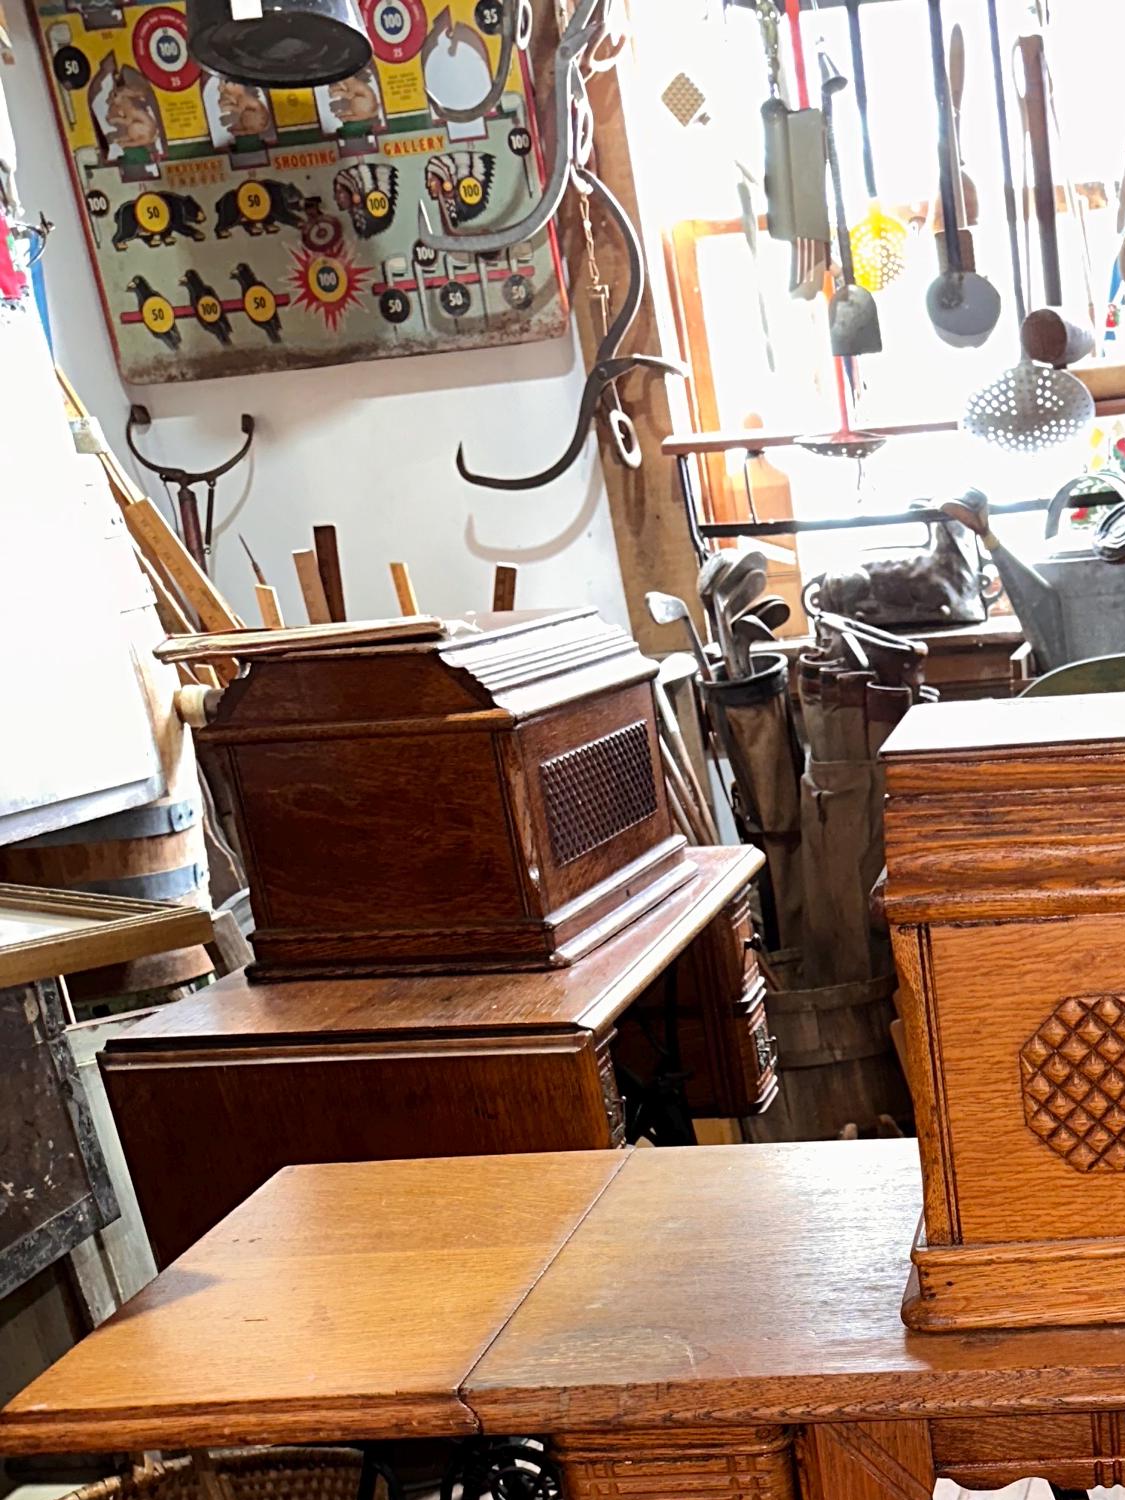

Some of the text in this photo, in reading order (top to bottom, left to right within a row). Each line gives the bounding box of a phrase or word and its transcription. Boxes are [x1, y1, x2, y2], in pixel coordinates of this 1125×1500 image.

[382, 14, 401, 29] 100
[483, 8, 498, 24] 35
[158, 42, 179, 57] 100
[64, 60, 80, 75] 50
[510, 132, 530, 150] 100
[273, 151, 337, 170] SHOOTING
[383, 136, 444, 156] GALLERY
[461, 183, 480, 198] 100
[88, 195, 108, 212] 100
[247, 194, 261, 208] 50
[369, 196, 387, 211] 100
[146, 206, 160, 220] 50
[416, 246, 435, 261] 100
[319, 271, 337, 287] 100
[449, 291, 464, 307] 50
[512, 288, 526, 301] 50
[201, 301, 218, 317] 100
[253, 296, 267, 310] 50
[388, 300, 402, 314] 50
[152, 308, 165, 322] 50
